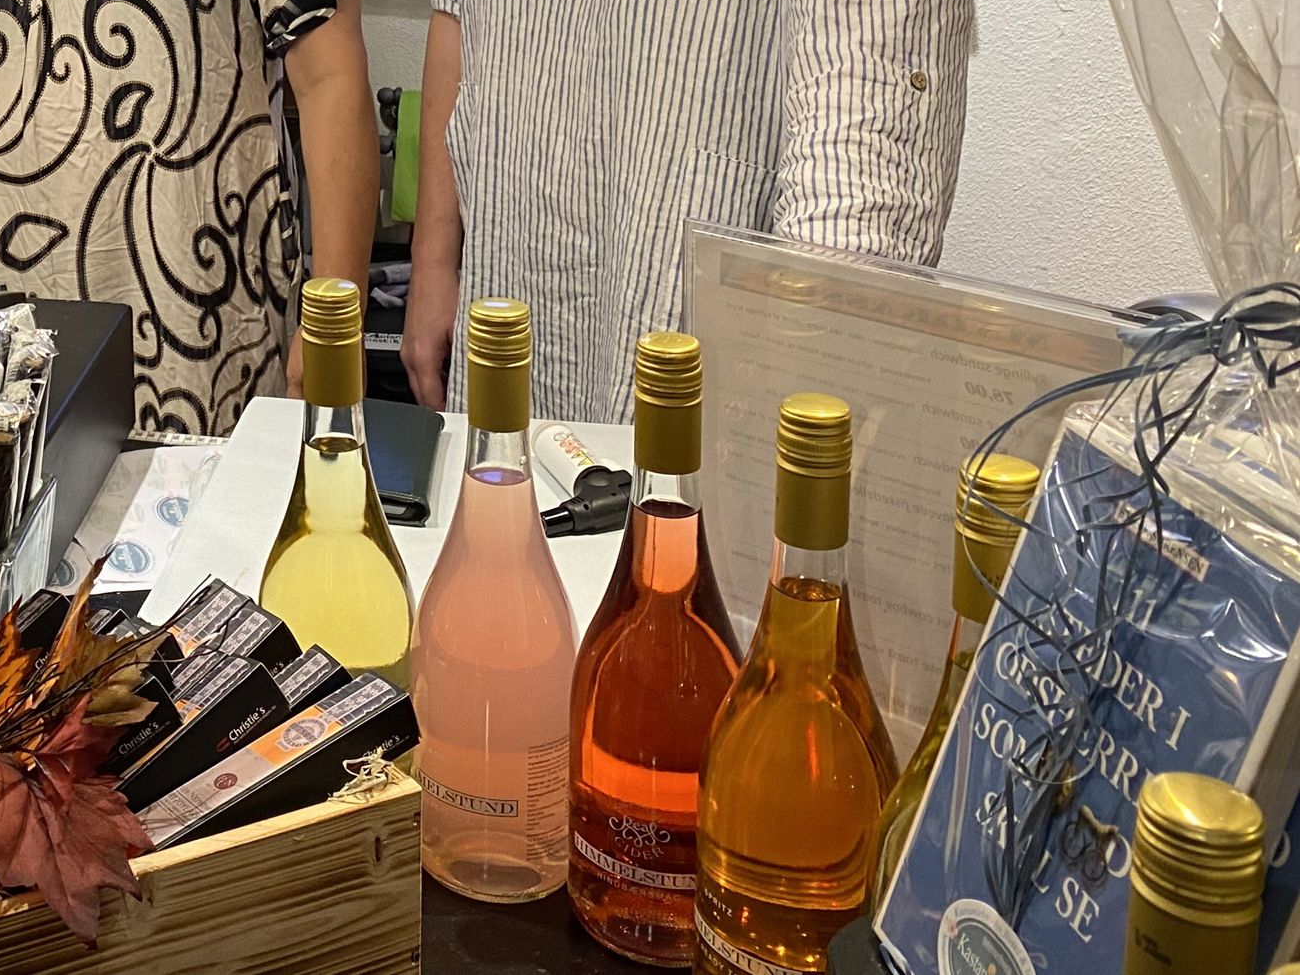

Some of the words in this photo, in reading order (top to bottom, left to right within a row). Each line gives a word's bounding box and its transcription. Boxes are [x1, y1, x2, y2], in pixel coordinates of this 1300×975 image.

[118, 721, 160, 756] Christie's
[228, 705, 267, 742] Christie's
[416, 769, 515, 815] MELSTUND
[614, 836, 664, 860] CIDER
[1055, 876, 1101, 944] SE
